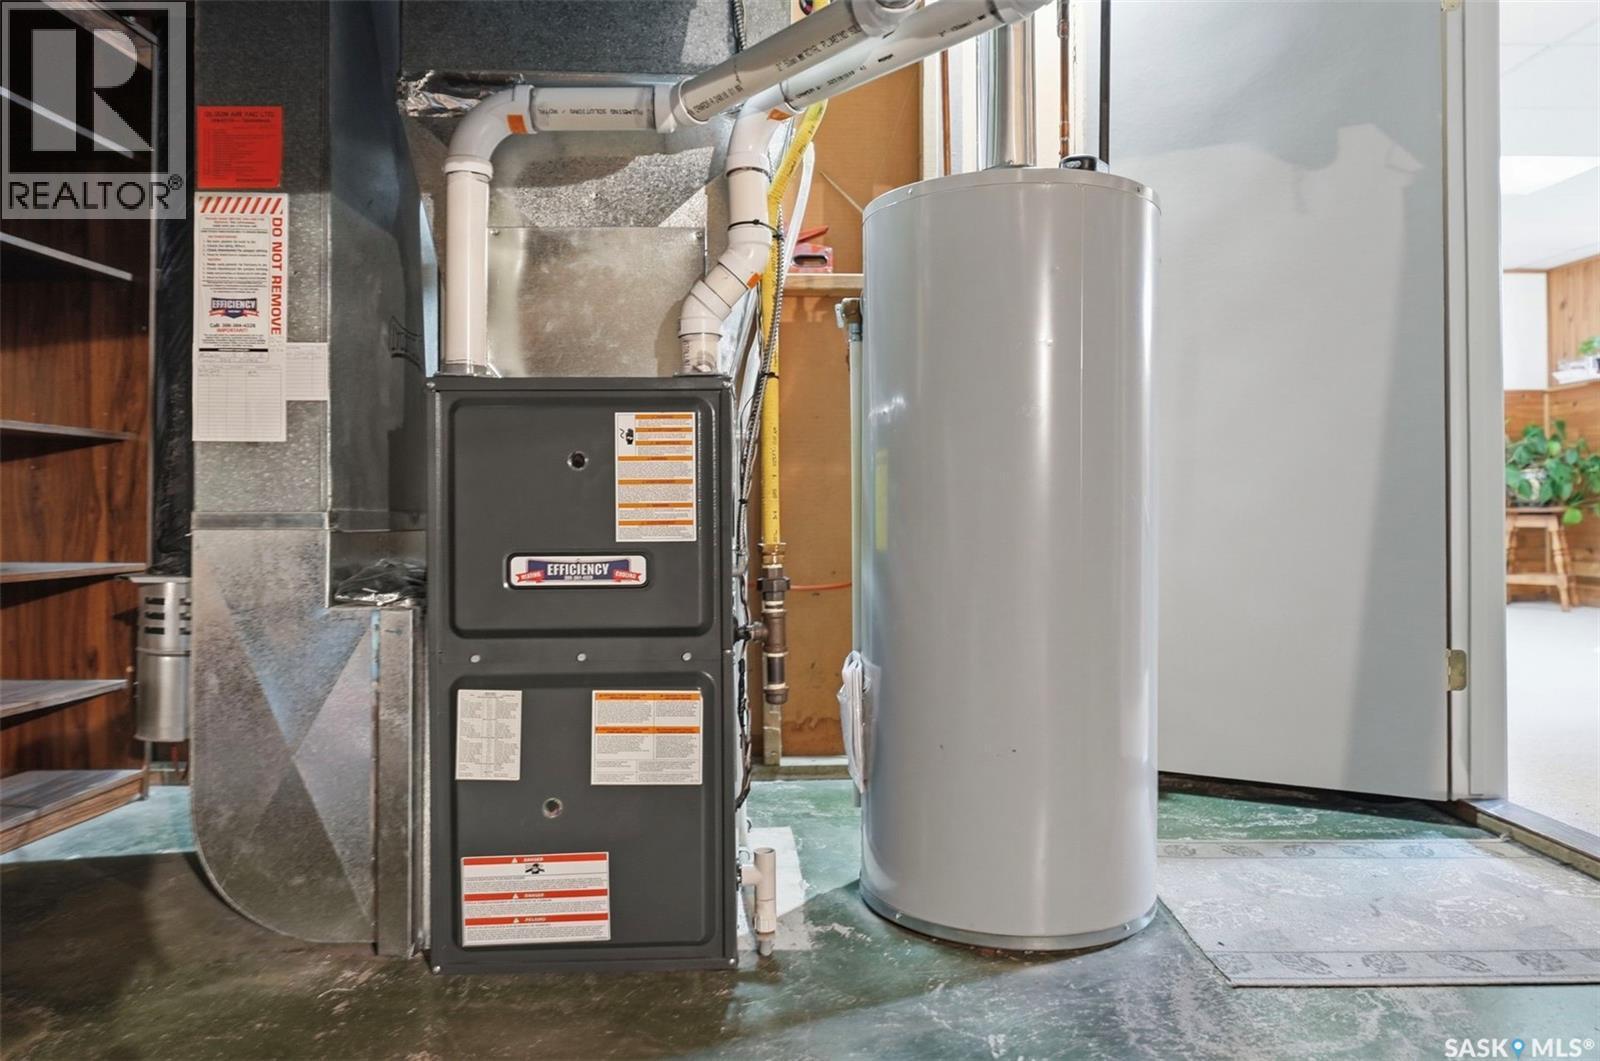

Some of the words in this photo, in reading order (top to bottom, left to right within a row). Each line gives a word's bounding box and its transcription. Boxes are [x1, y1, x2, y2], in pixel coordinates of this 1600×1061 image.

[272, 217, 282, 237] DO
[272, 241, 282, 271] NOT
[212, 300, 256, 309] EFFICIENCY
[271, 275, 282, 335] REMOVE
[547, 564, 610, 575] EFFICIENCY
